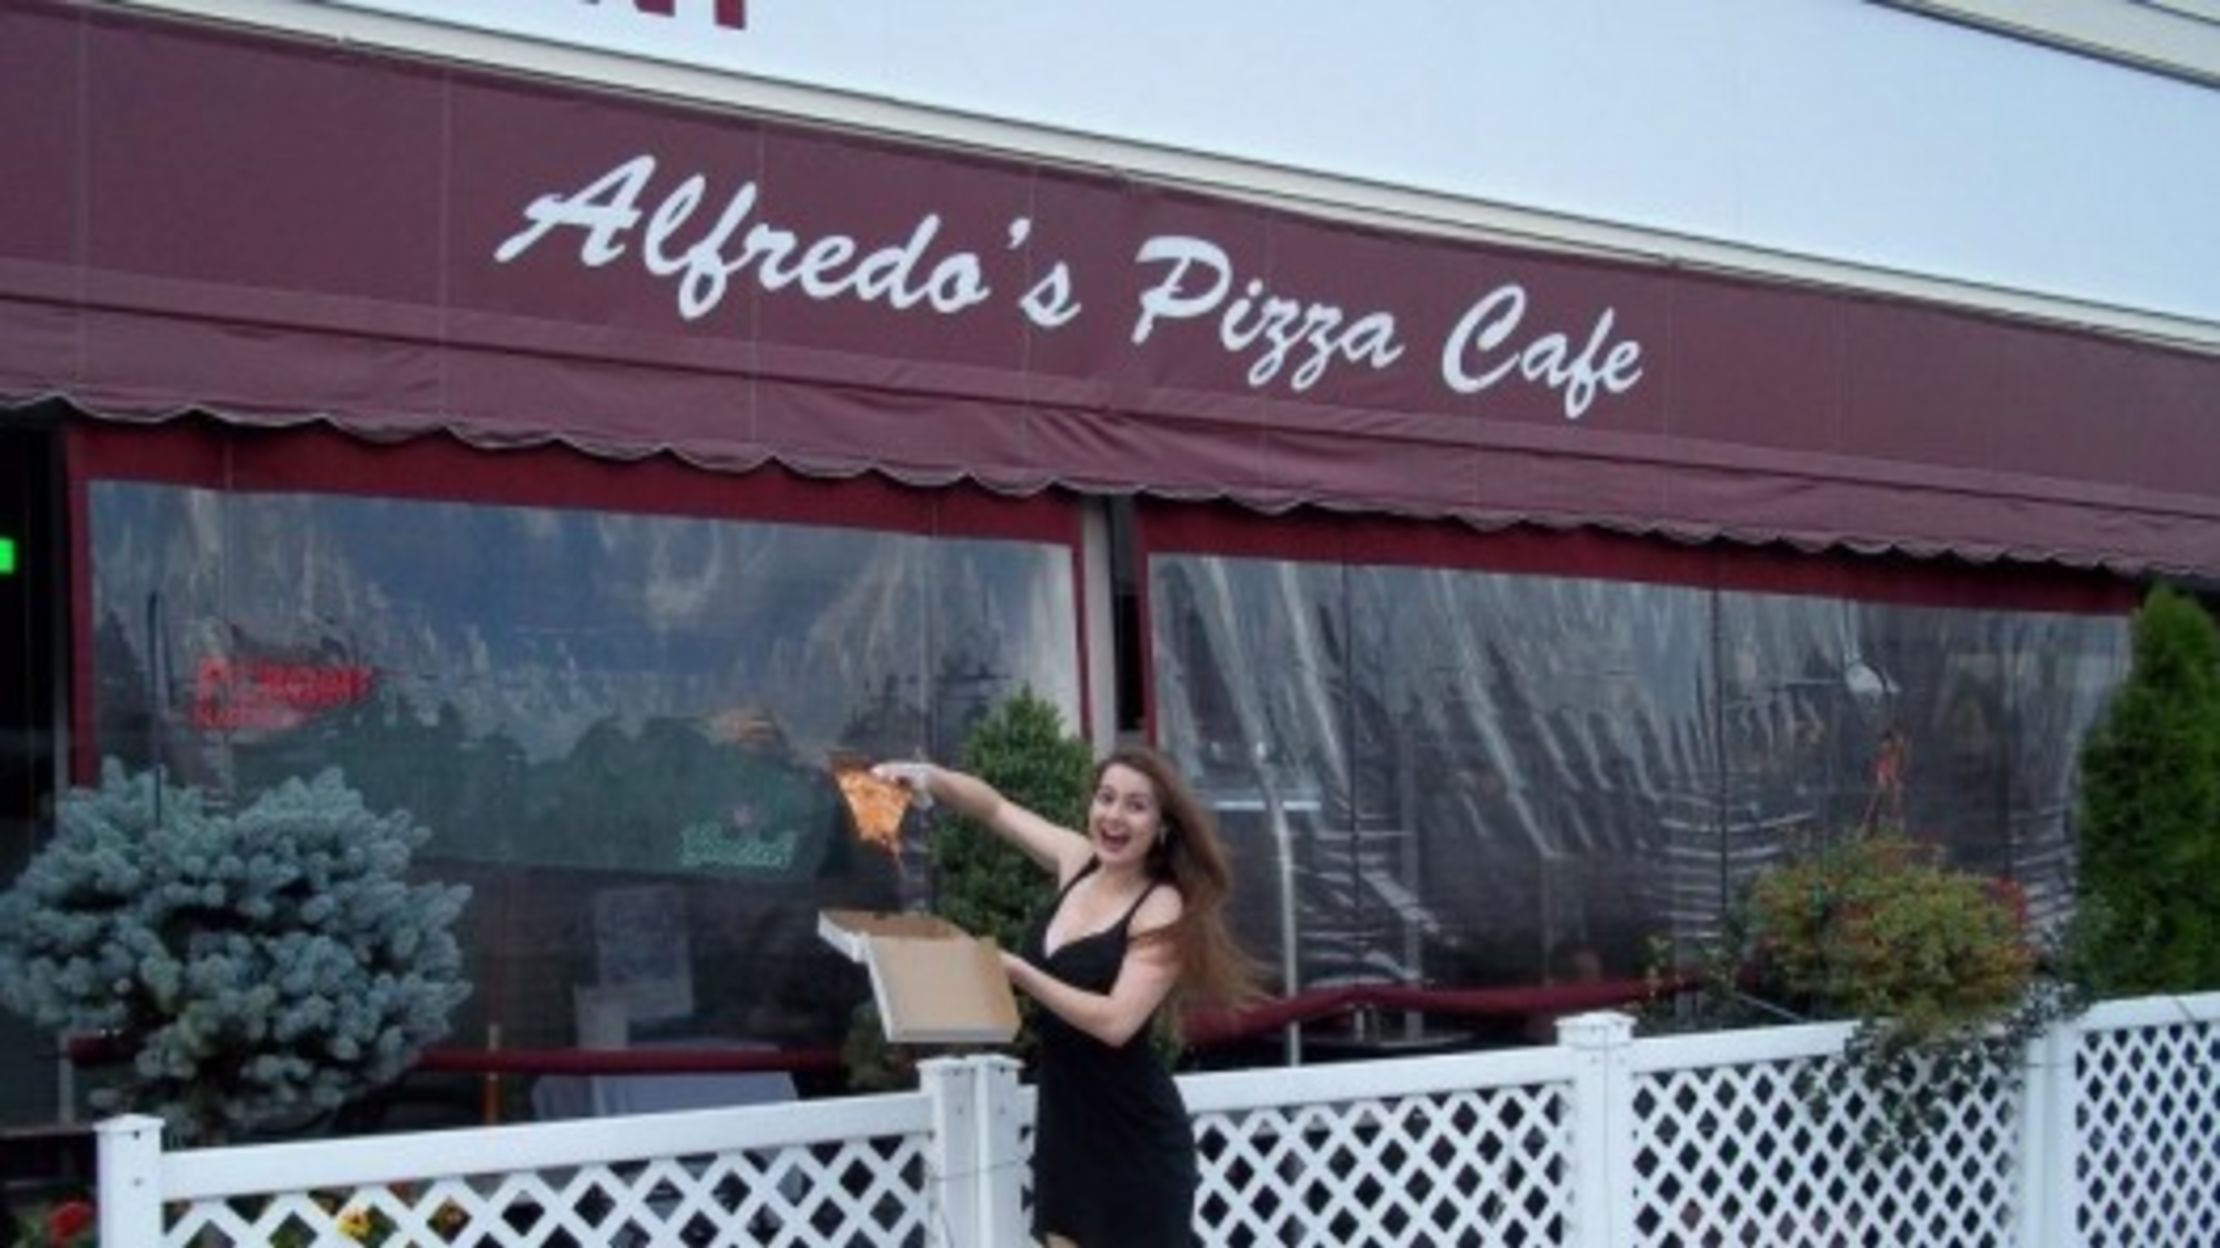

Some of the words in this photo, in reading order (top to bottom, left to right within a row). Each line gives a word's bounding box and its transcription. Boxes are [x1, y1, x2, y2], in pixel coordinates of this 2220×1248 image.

[493, 154, 1083, 328] Alfredo's
[1131, 235, 1405, 391] Pizza
[1441, 284, 1643, 419] Cafe
